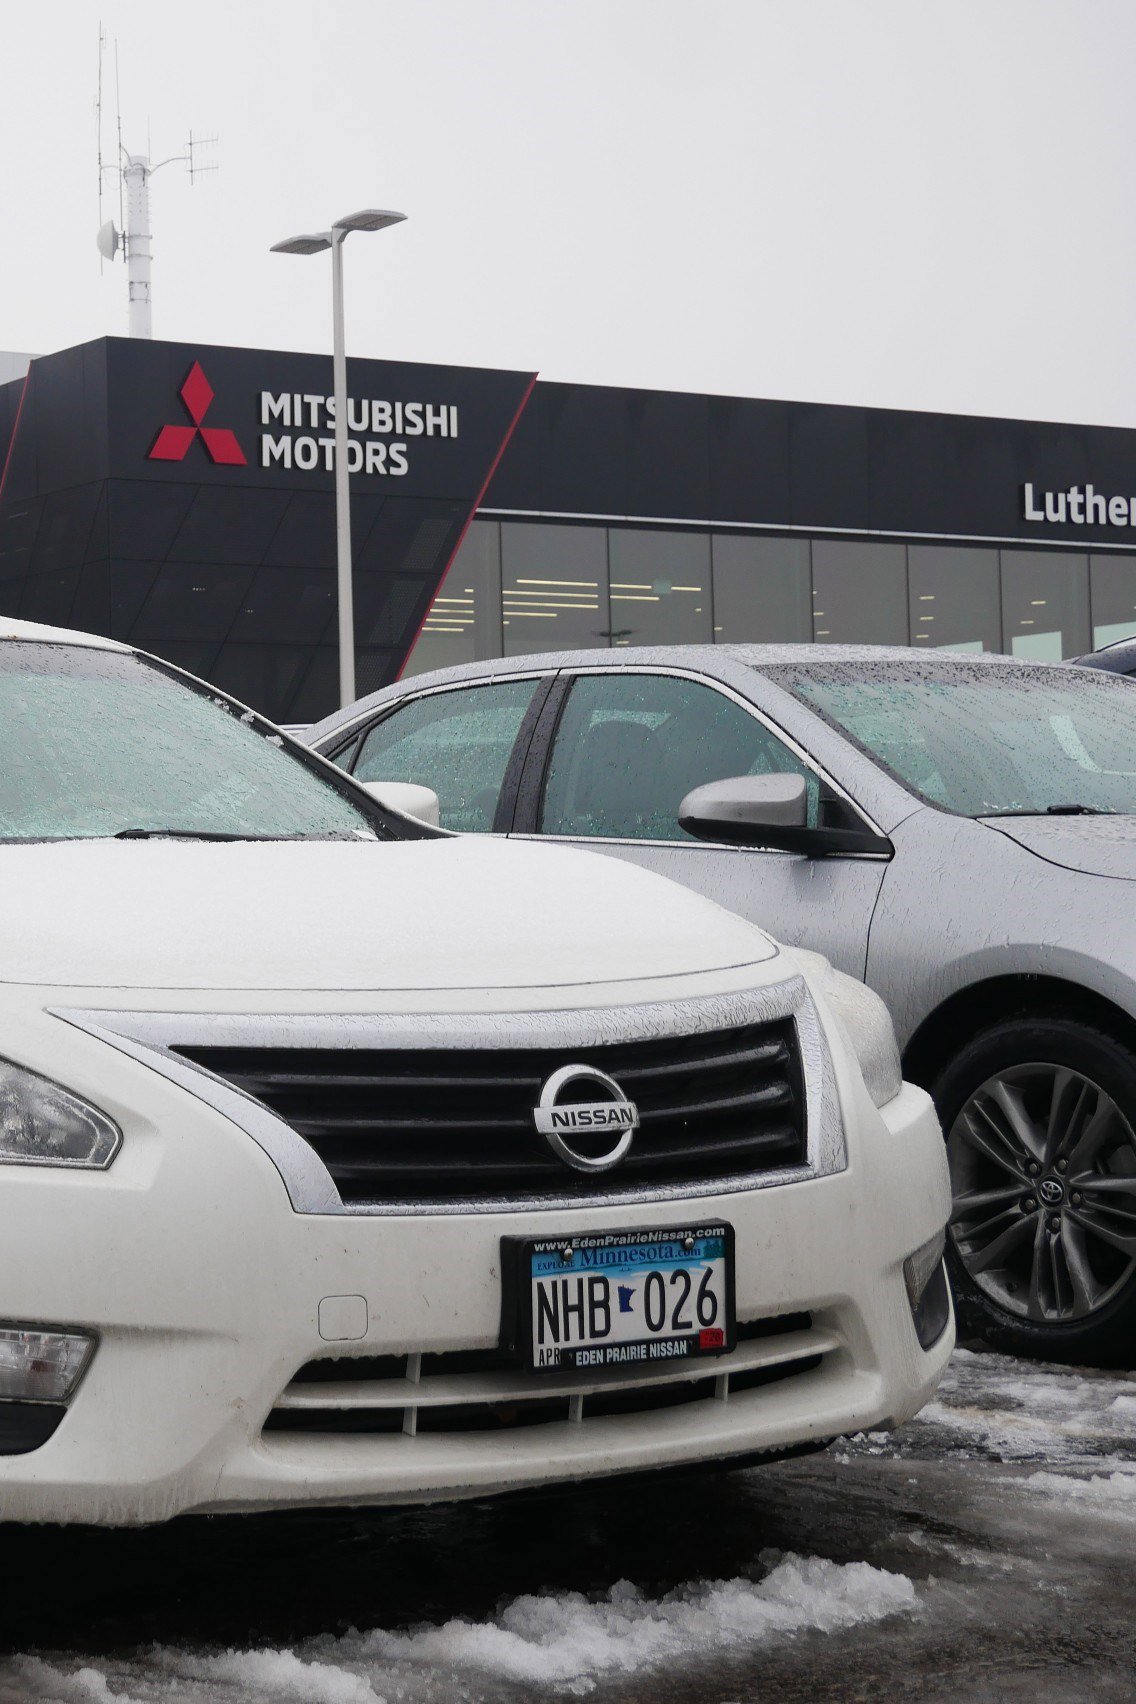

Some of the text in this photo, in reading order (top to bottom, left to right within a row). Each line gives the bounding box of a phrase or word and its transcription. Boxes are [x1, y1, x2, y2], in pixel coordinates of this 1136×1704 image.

[261, 390, 459, 438] MITSUBISHI
[262, 433, 410, 476] MOTORS
[551, 1108, 634, 1128] NISSAN
[534, 1227, 725, 1252] www.EdenPrairieNissan.com
[537, 1266, 718, 1345] NHB 026
[539, 1348, 561, 1367] APR
[575, 1339, 687, 1366] EDEN PRAIRIE NISSAN
